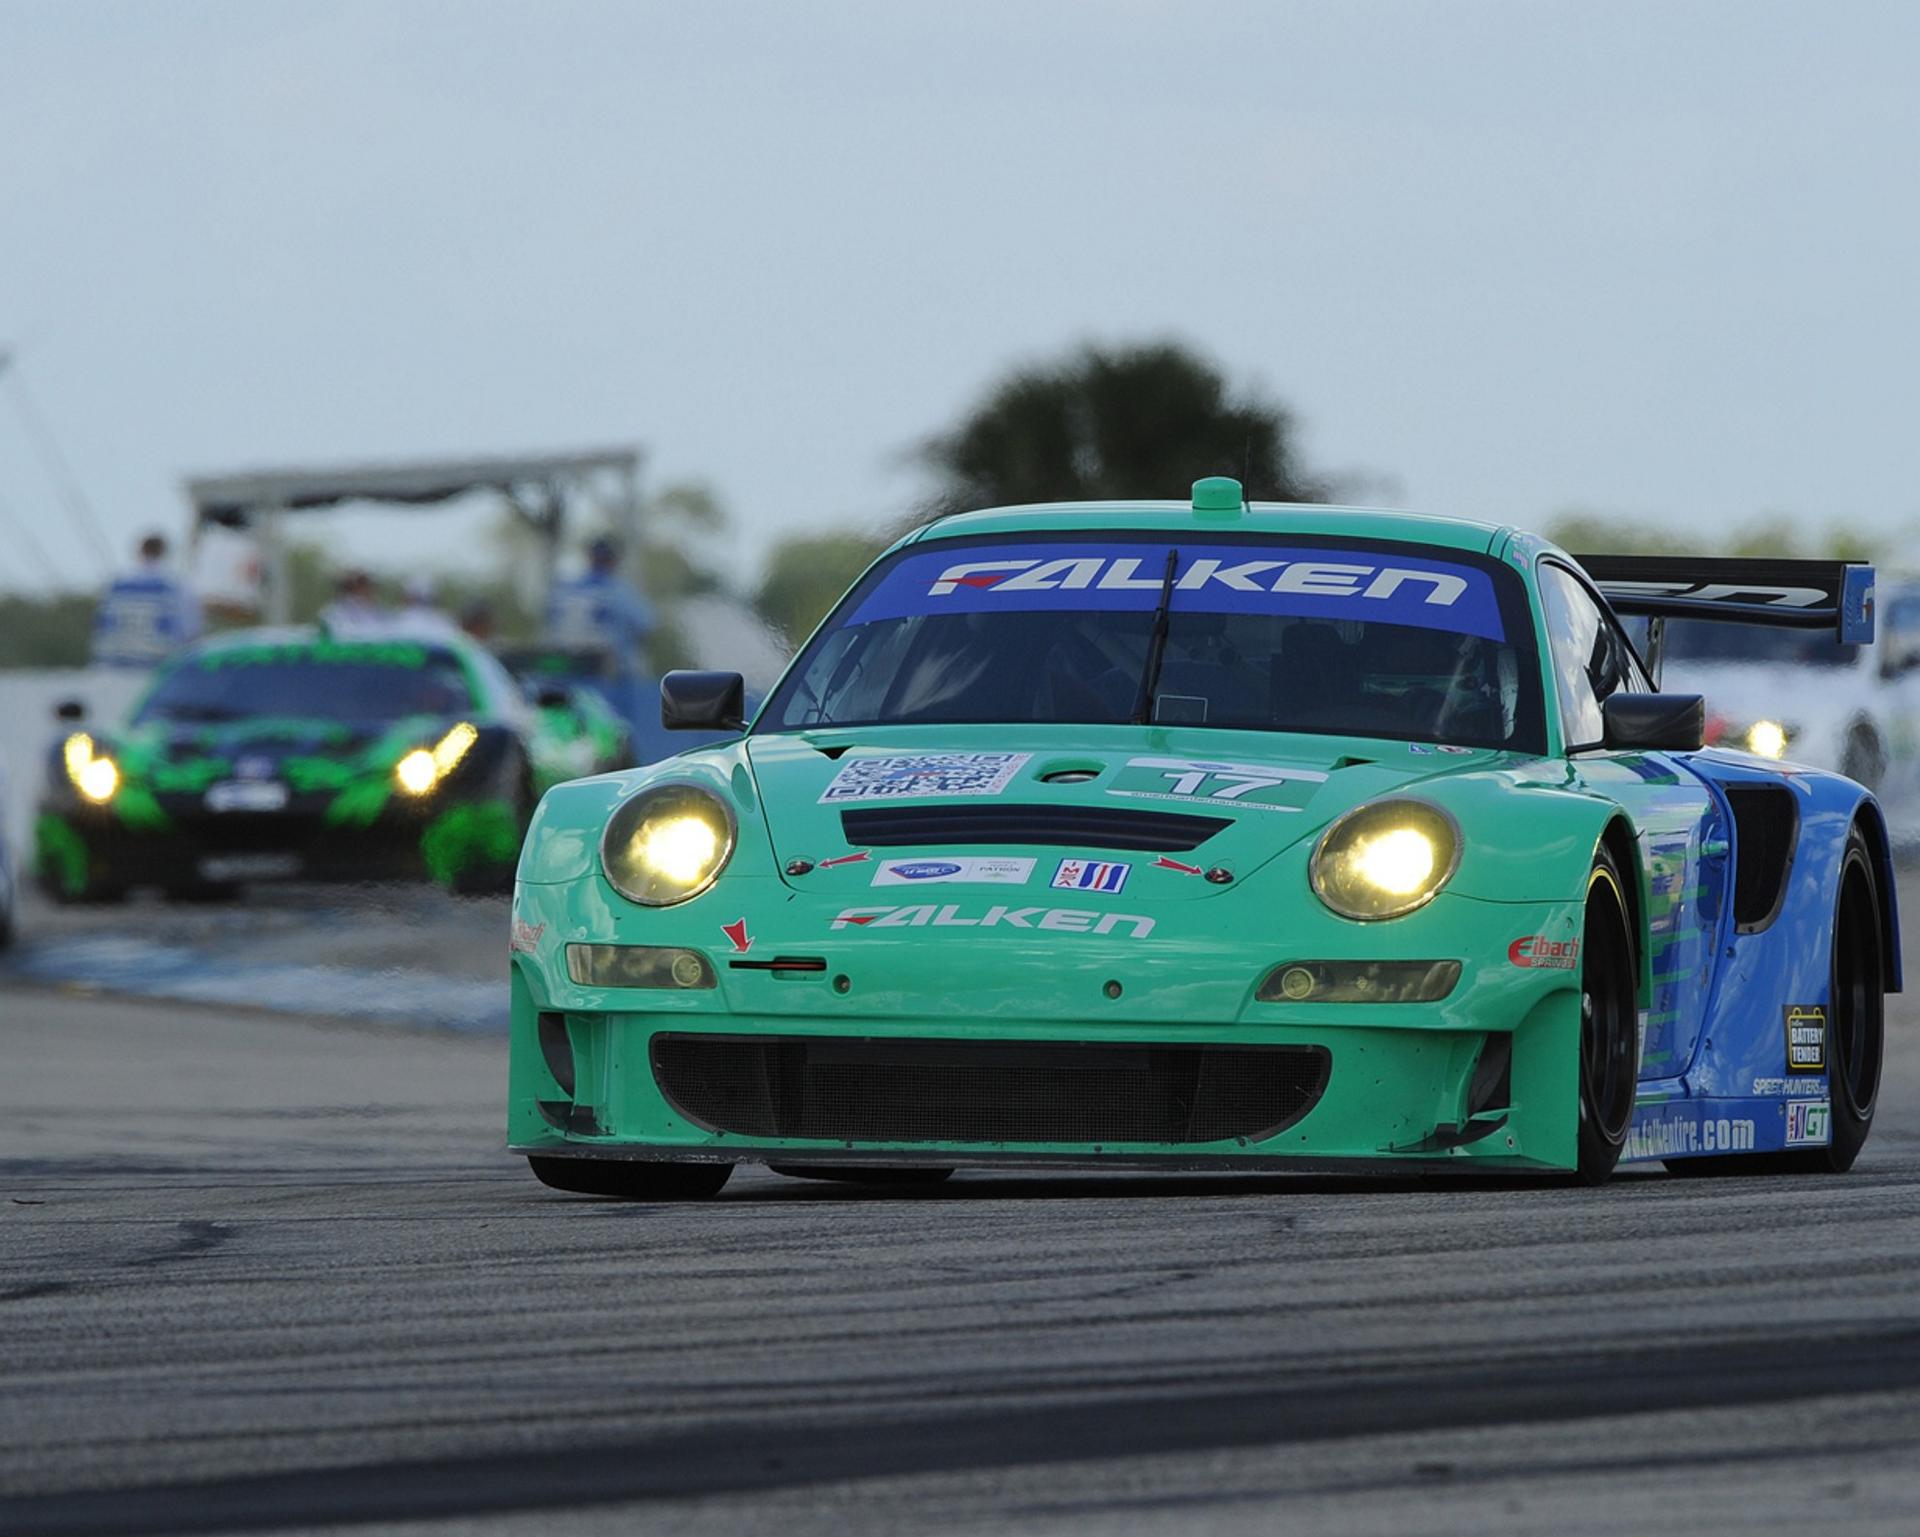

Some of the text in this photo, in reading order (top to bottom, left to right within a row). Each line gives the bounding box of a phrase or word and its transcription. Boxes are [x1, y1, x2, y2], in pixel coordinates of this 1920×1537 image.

[924, 557, 1469, 605] FALKEN
[1161, 770, 1284, 799] 17
[828, 904, 1157, 939] FALKEN
[1508, 936, 1579, 968] Eibach
[1791, 1028, 1824, 1044] BATTERY
[1792, 1046, 1821, 1063] TENDER
[1806, 1108, 1828, 1137] GT
